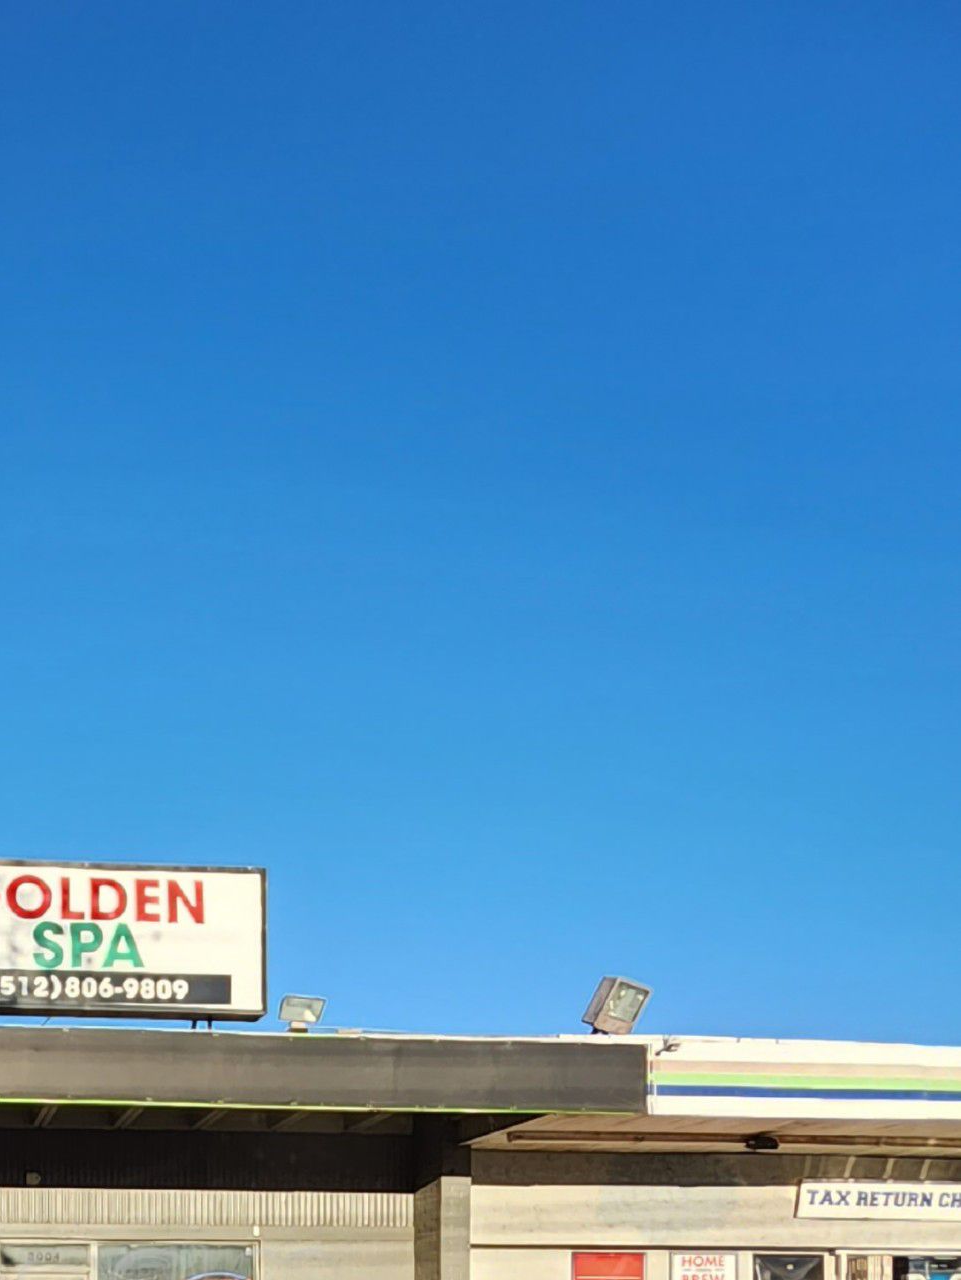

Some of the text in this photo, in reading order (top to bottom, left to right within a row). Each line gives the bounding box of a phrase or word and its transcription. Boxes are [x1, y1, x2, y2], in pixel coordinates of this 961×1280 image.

[32, 921, 144, 969] SPA
[807, 1190, 850, 1206] TAX
[855, 1191, 933, 1207] RETURN
[681, 1255, 725, 1267] HOME
